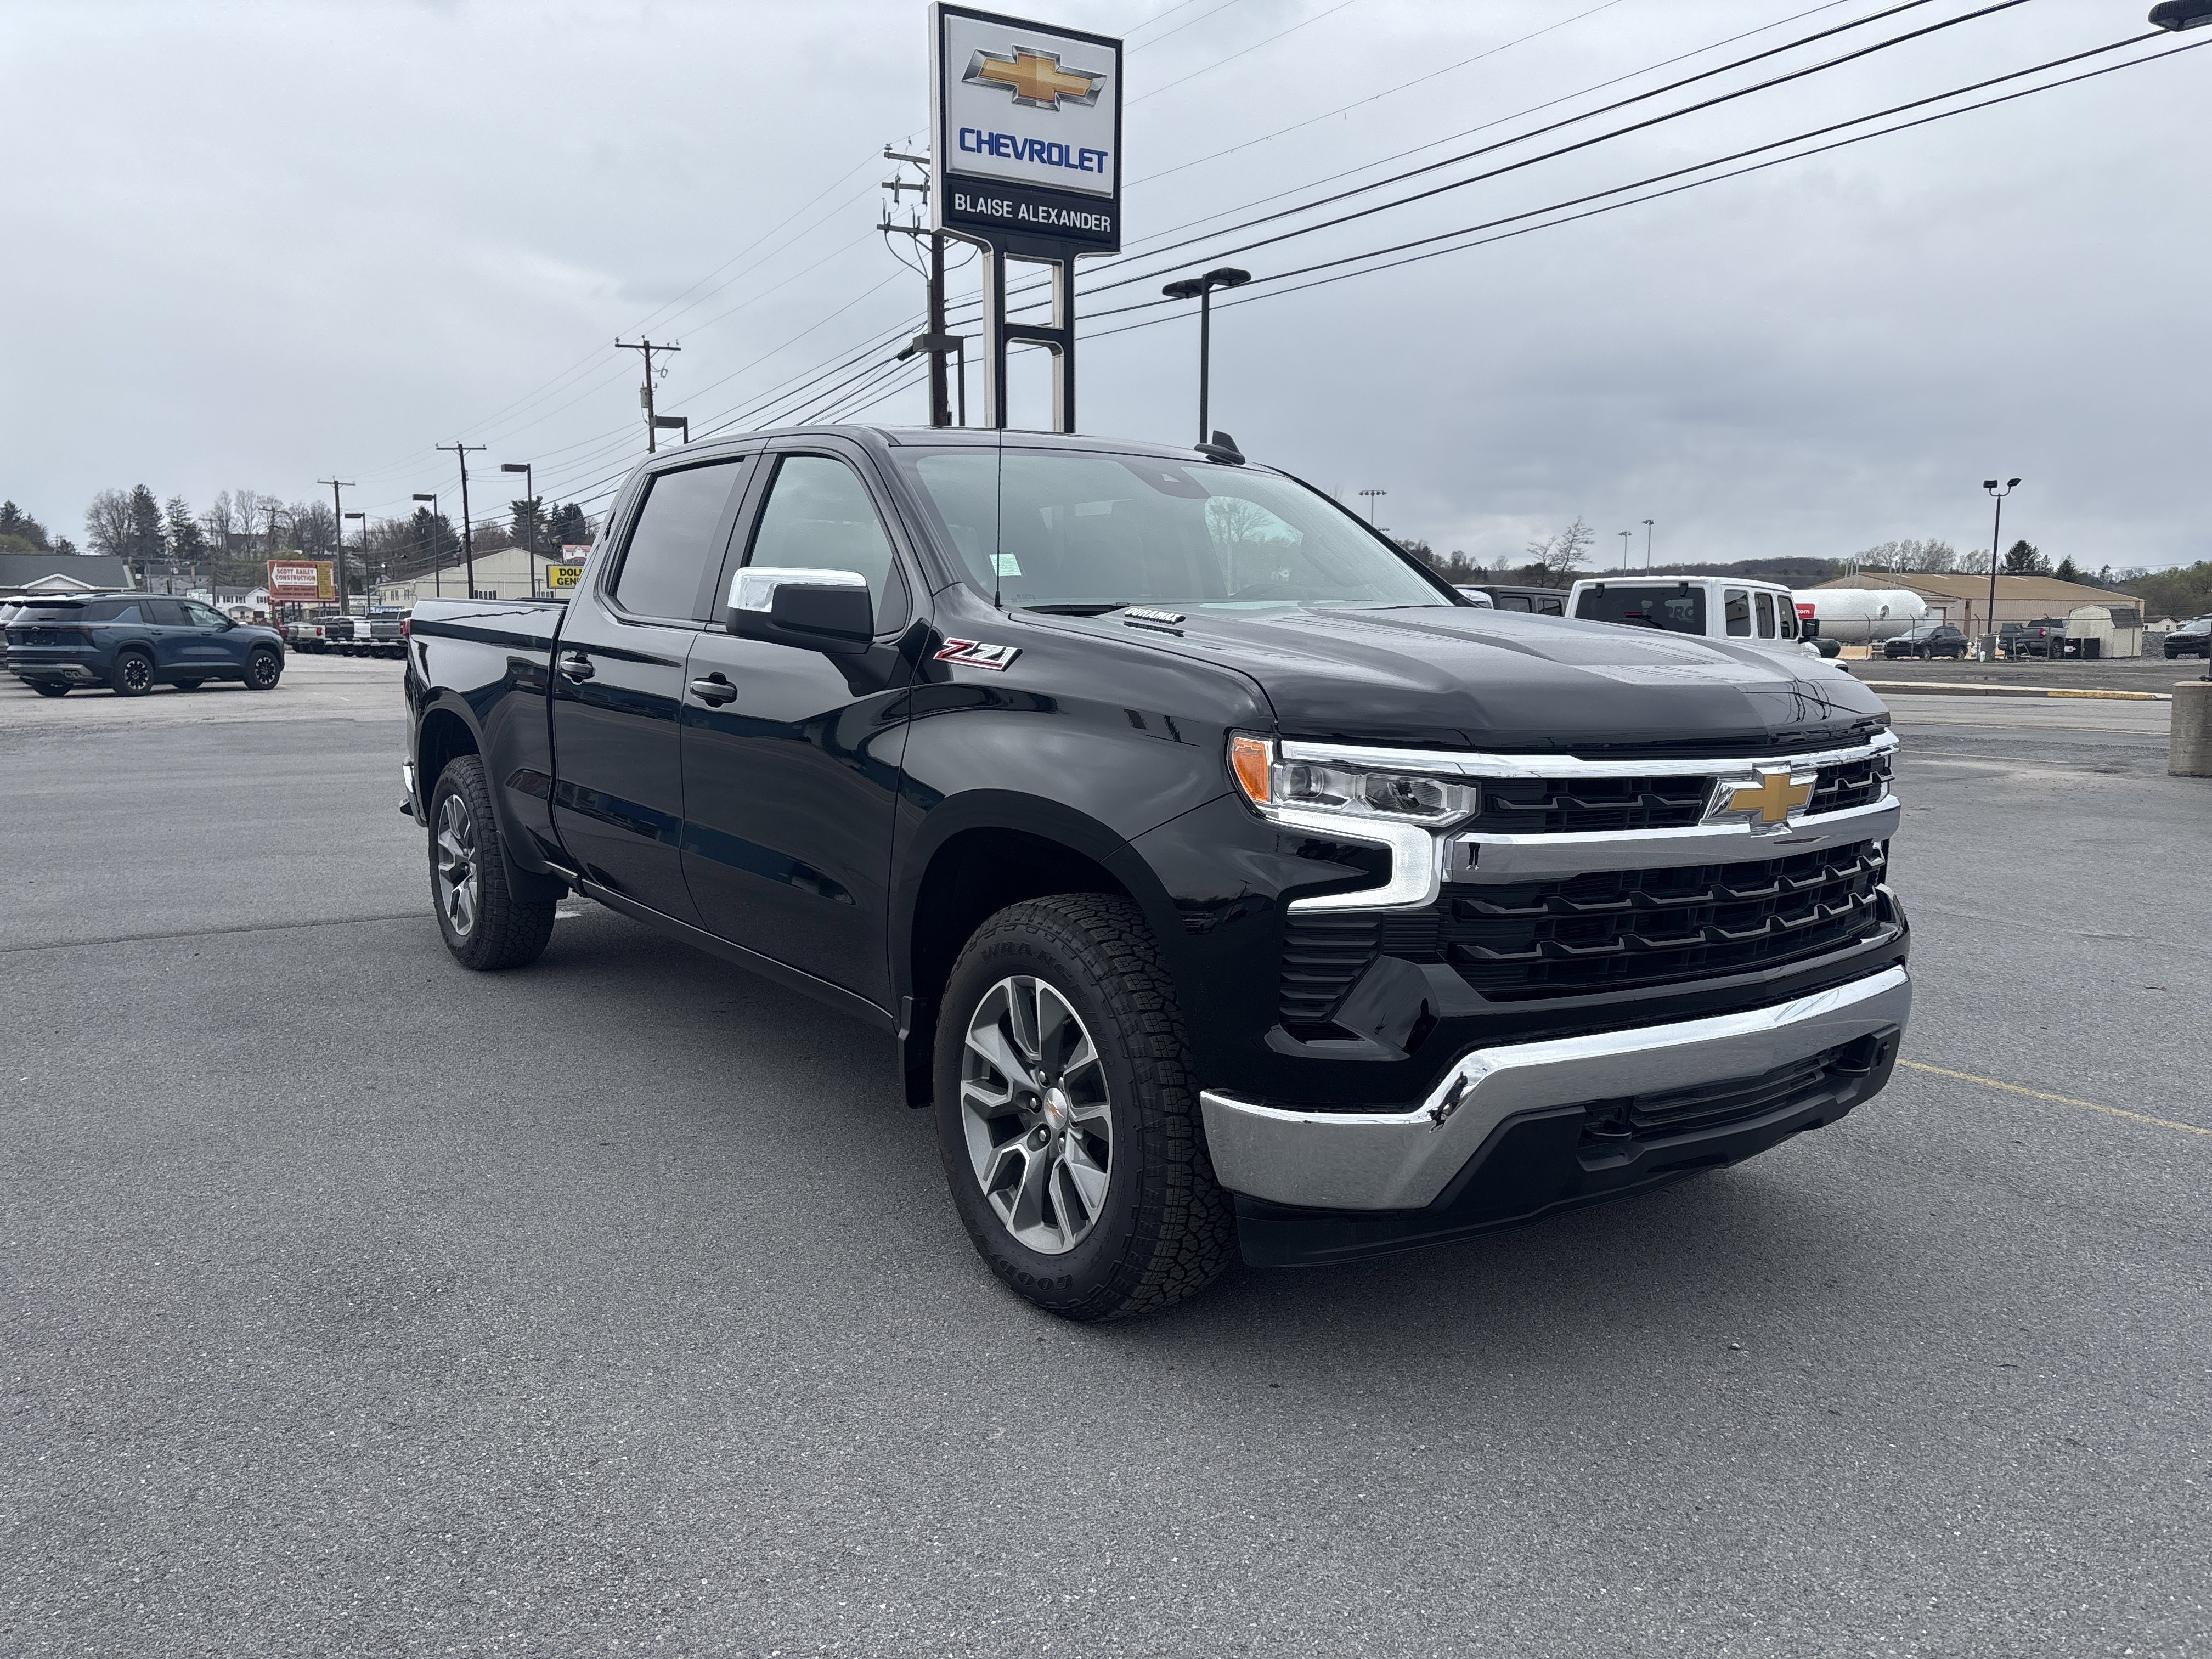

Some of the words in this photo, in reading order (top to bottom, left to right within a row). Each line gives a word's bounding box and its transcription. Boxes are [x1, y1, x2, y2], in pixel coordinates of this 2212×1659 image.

[959, 127, 1108, 173] CHEVROLET
[955, 193, 1013, 218] BLAISE
[1018, 204, 1110, 232] ALEXANDER
[1124, 607, 1184, 623] DURAMAX
[933, 637, 1020, 671] Z71
